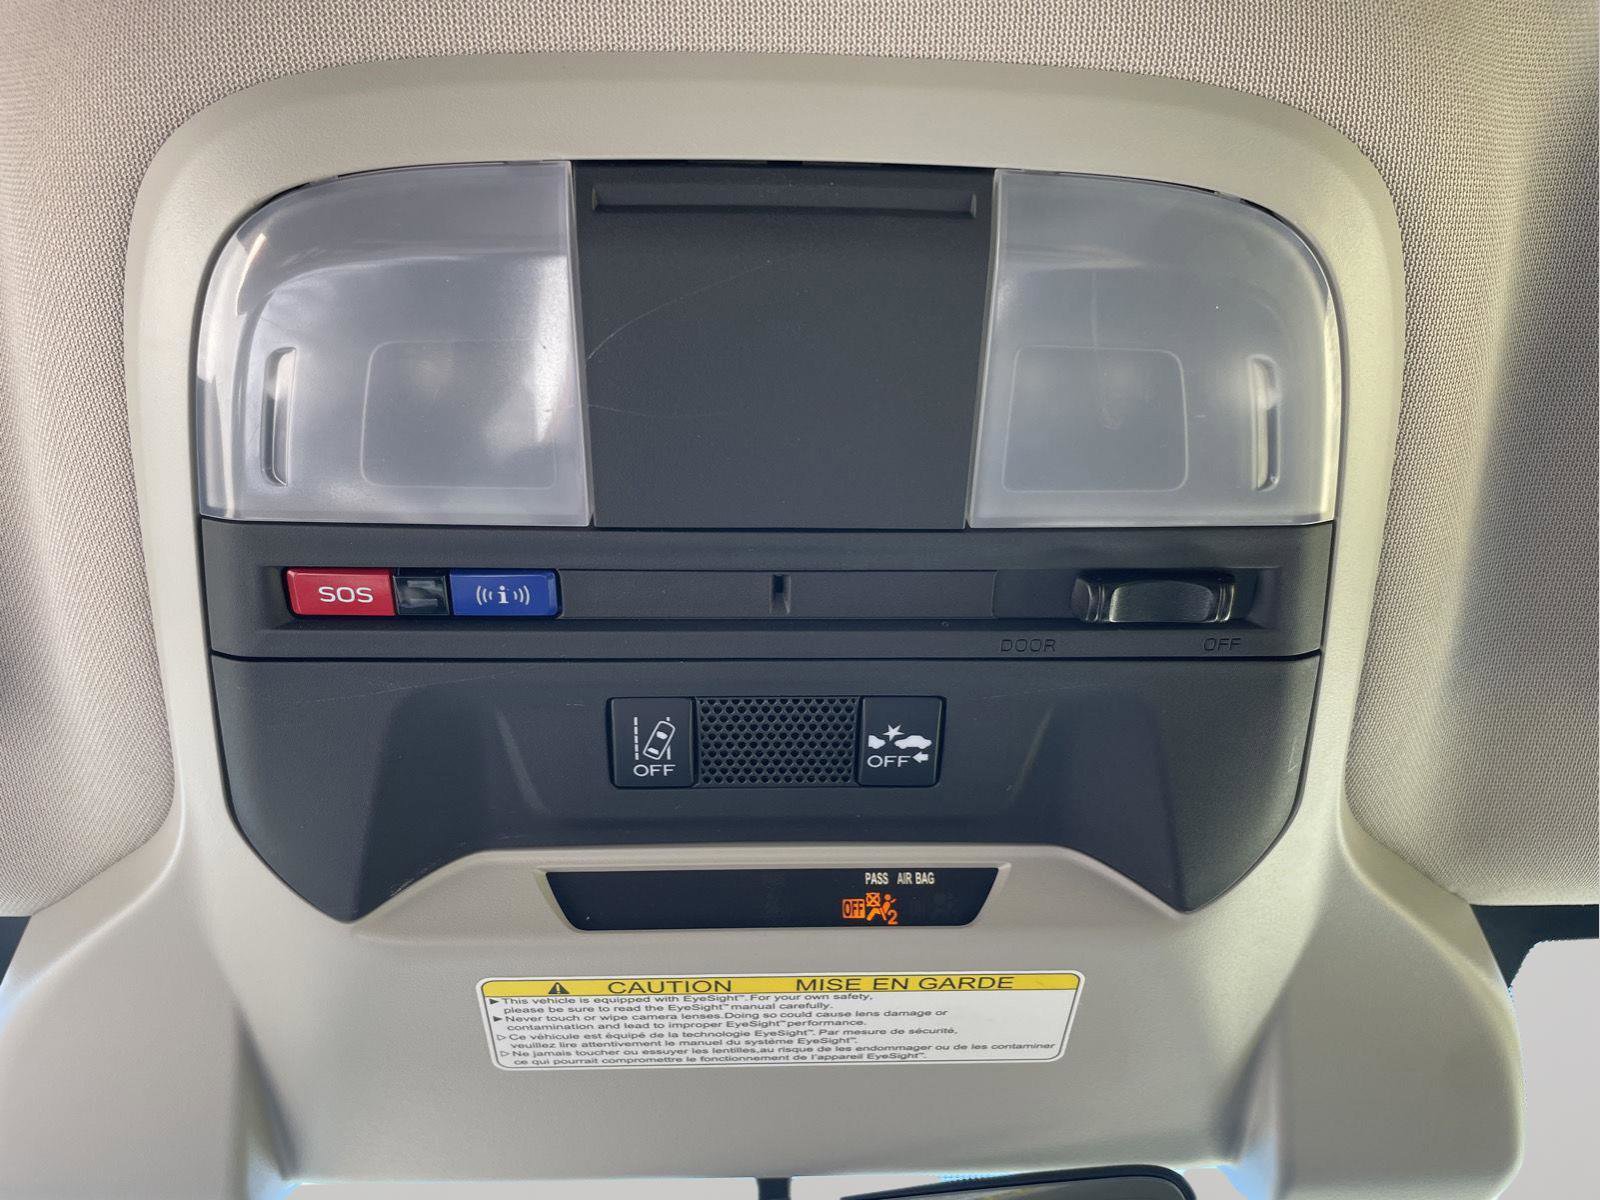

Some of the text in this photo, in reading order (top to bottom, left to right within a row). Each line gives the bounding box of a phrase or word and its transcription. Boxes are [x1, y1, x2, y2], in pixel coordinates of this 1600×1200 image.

[318, 586, 374, 603] SOS
[1000, 639, 1056, 652] DOOR
[1203, 638, 1241, 651] OFF
[867, 755, 911, 767] OFF
[633, 764, 676, 777] OFF
[864, 872, 935, 885] PASS AIR BAG
[844, 900, 864, 917] OFF
[608, 976, 1014, 994] CAUTION MISE EN GARDE
[594, 996, 650, 1005] equipped
[775, 994, 800, 1002] your
[504, 1006, 544, 1014] please
[779, 1002, 833, 1010] carefully.
[669, 1021, 722, 1029] improper
[787, 1019, 866, 1028] performance.
[606, 1032, 645, 1040] équipé
